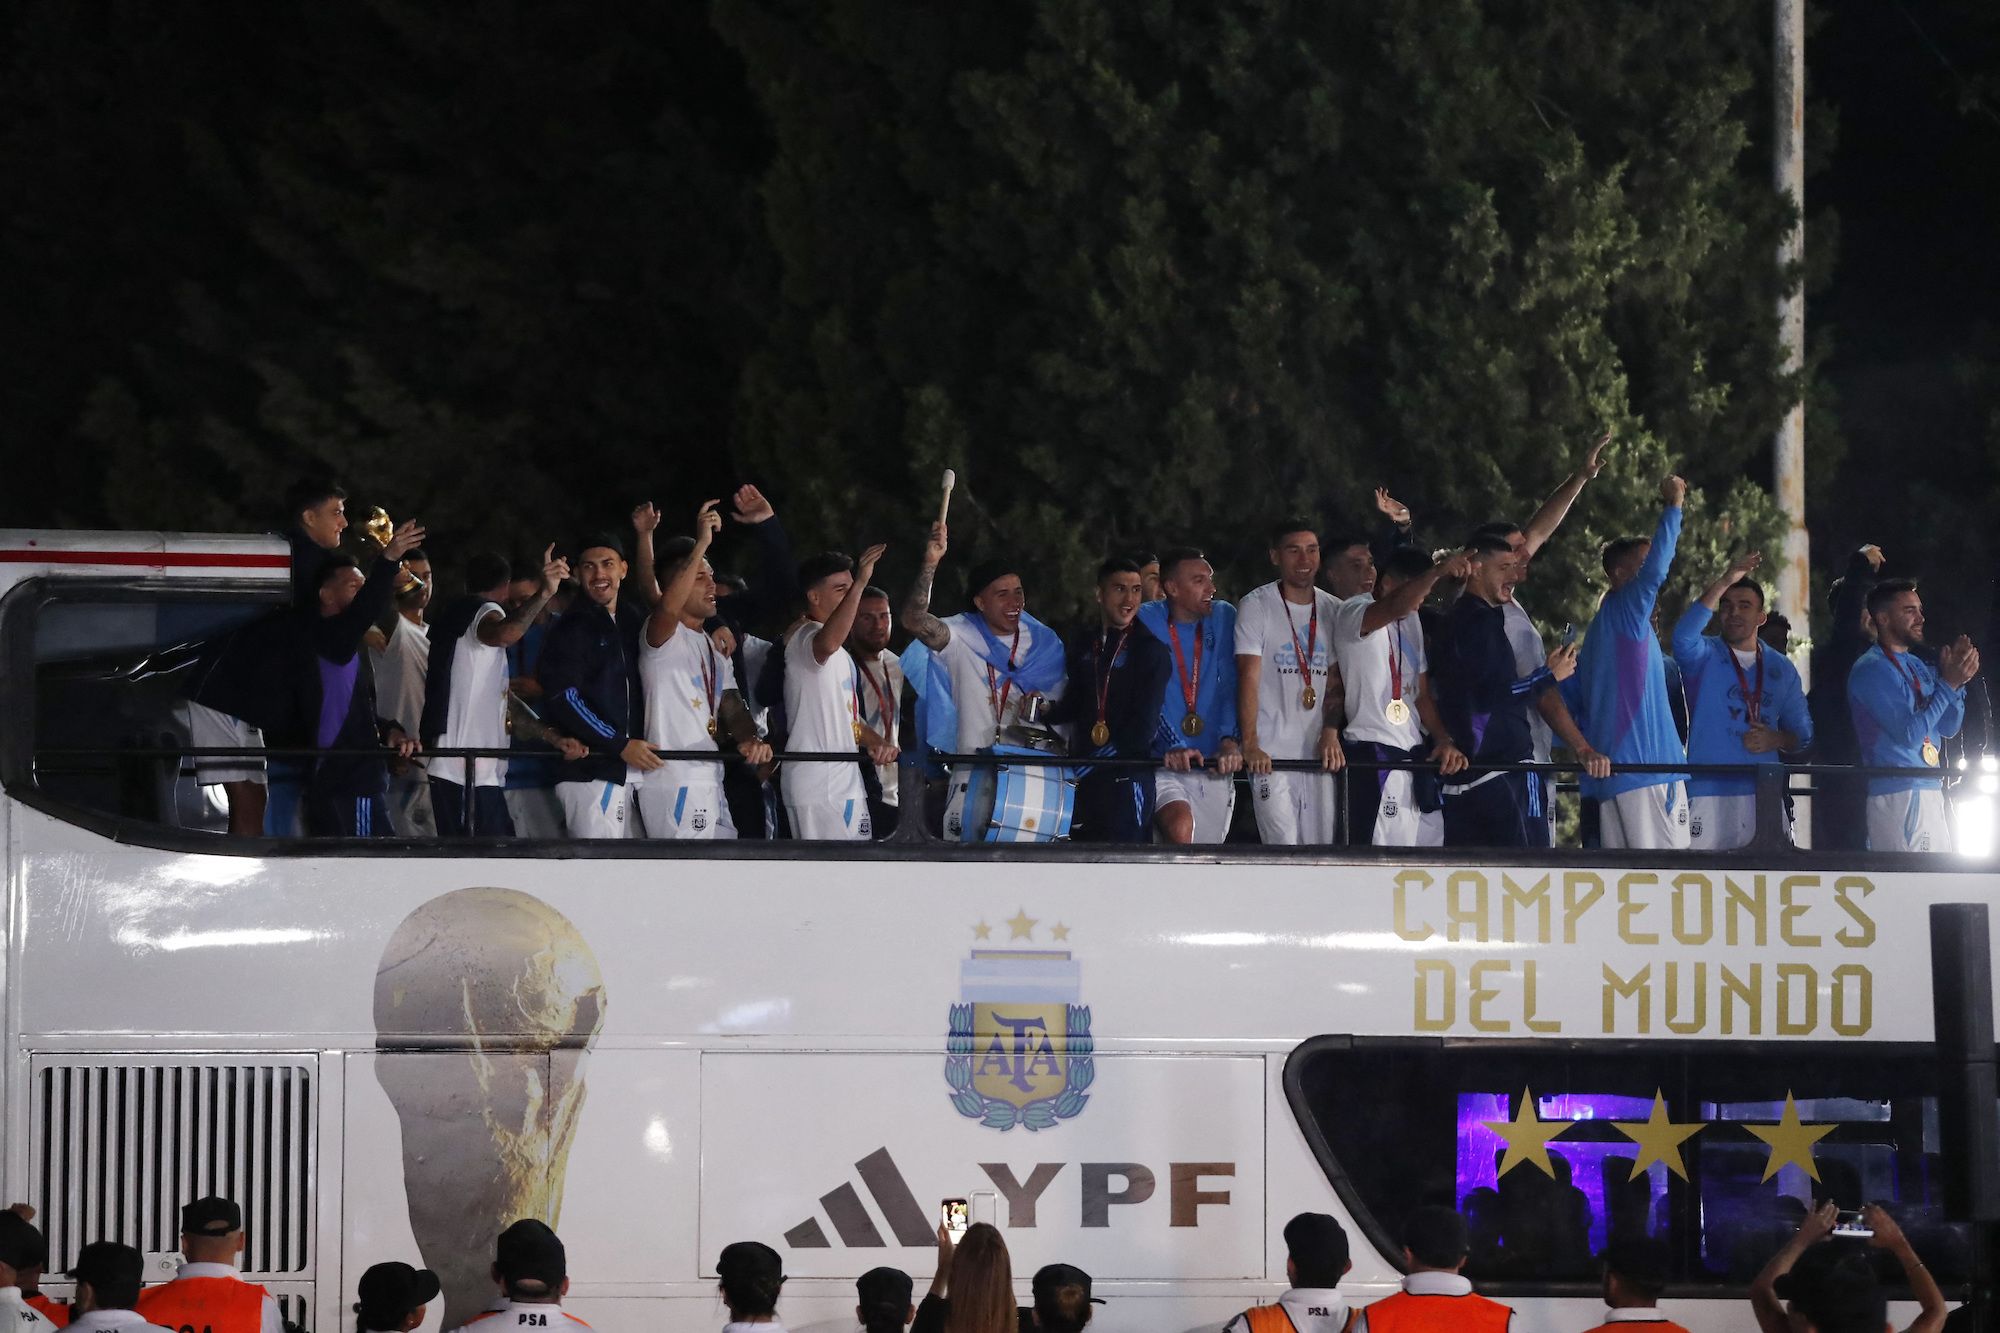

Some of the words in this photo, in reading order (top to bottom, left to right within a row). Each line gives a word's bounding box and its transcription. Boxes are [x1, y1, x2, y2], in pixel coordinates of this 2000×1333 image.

[1277, 668, 1328, 677] ARGEINA
[1393, 869, 1876, 948] CAMPEONES
[1414, 959, 1561, 1032] DEL
[1602, 961, 1873, 1036] MUNDO
[977, 1162, 1236, 1228] YPF
[20, 1311, 40, 1322] PSA
[1308, 1307, 1330, 1317] PSA
[518, 1313, 547, 1326] PSA
